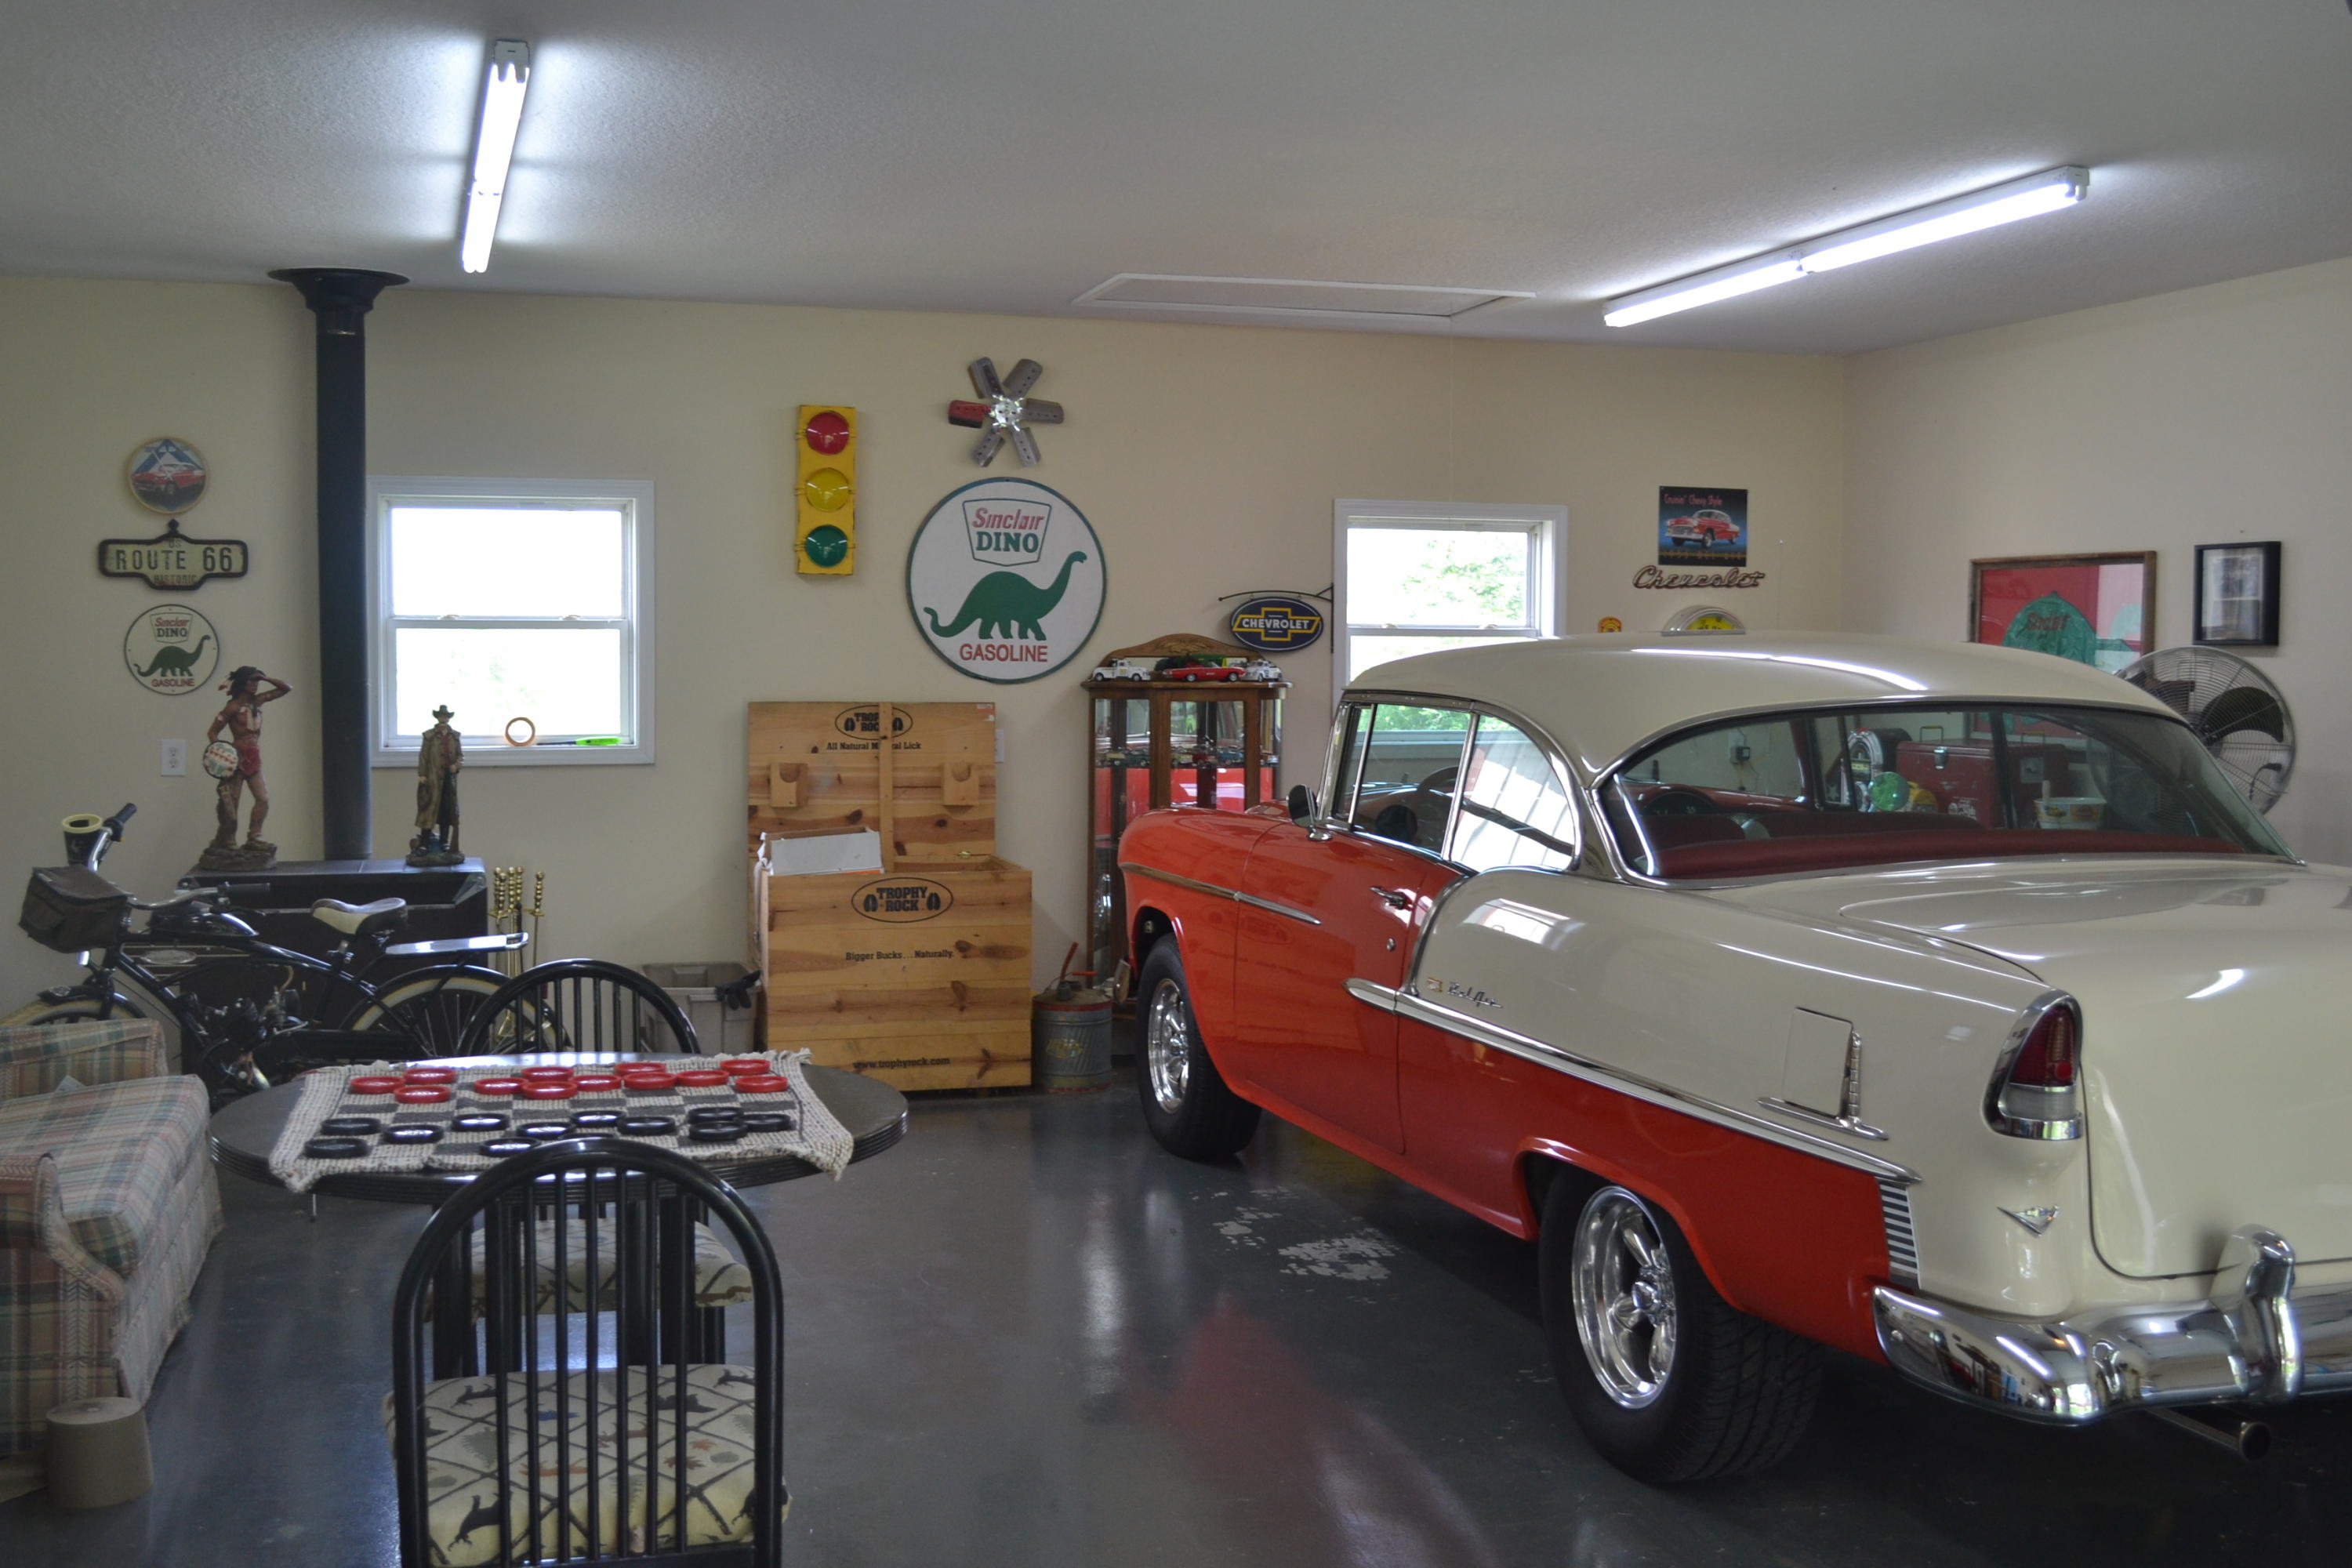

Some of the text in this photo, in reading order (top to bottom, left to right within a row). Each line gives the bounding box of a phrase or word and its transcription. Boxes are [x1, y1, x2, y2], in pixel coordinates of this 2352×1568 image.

[972, 507, 1045, 530] Sinclair
[169, 539, 181, 548] US
[975, 531, 1039, 554] DINO
[116, 547, 233, 572] ROUTE 66
[1632, 564, 1766, 589] Chevrolet
[154, 617, 190, 627] Sinclair
[1242, 619, 1309, 629] CHEVROLET
[157, 628, 187, 637] DINO
[960, 643, 1047, 662] GASOLINE
[854, 712, 879, 722] TROP
[861, 722, 879, 731] ROC
[877, 887, 927, 899] TROPHY
[885, 899, 919, 911] ROCK
[845, 952, 874, 962] Bigger
